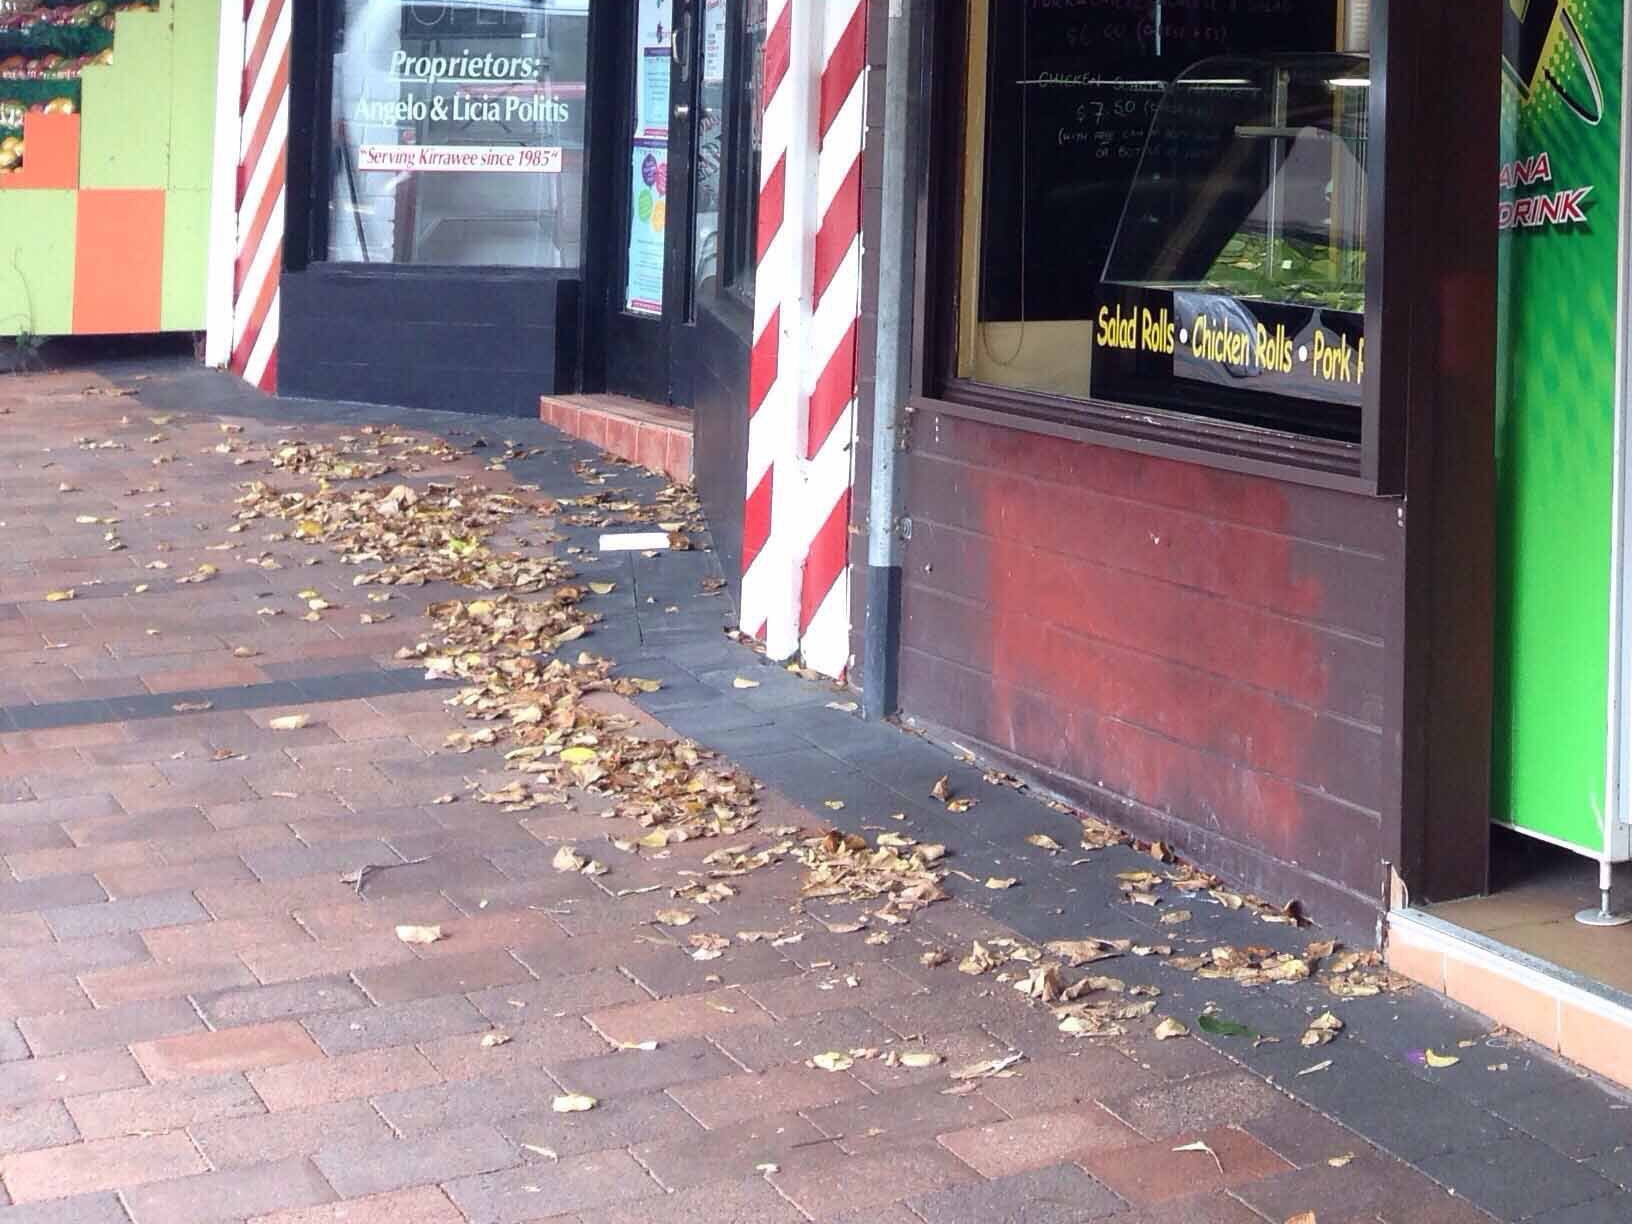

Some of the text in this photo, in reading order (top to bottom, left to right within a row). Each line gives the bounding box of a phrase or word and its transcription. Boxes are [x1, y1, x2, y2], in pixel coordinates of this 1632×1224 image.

[390, 49, 540, 83] Proprietors:
[356, 92, 569, 126] Angelo & Licia Politis
[419, 150, 478, 167] Kirrawee
[481, 150, 515, 167] since
[1498, 185, 1594, 230] DRINK
[1097, 304, 1137, 349] Salad
[1142, 308, 1175, 355] Rolls
[1192, 313, 1250, 367] Chicken
[1255, 322, 1293, 373] Rolls
[1312, 330, 1351, 382] Pork
